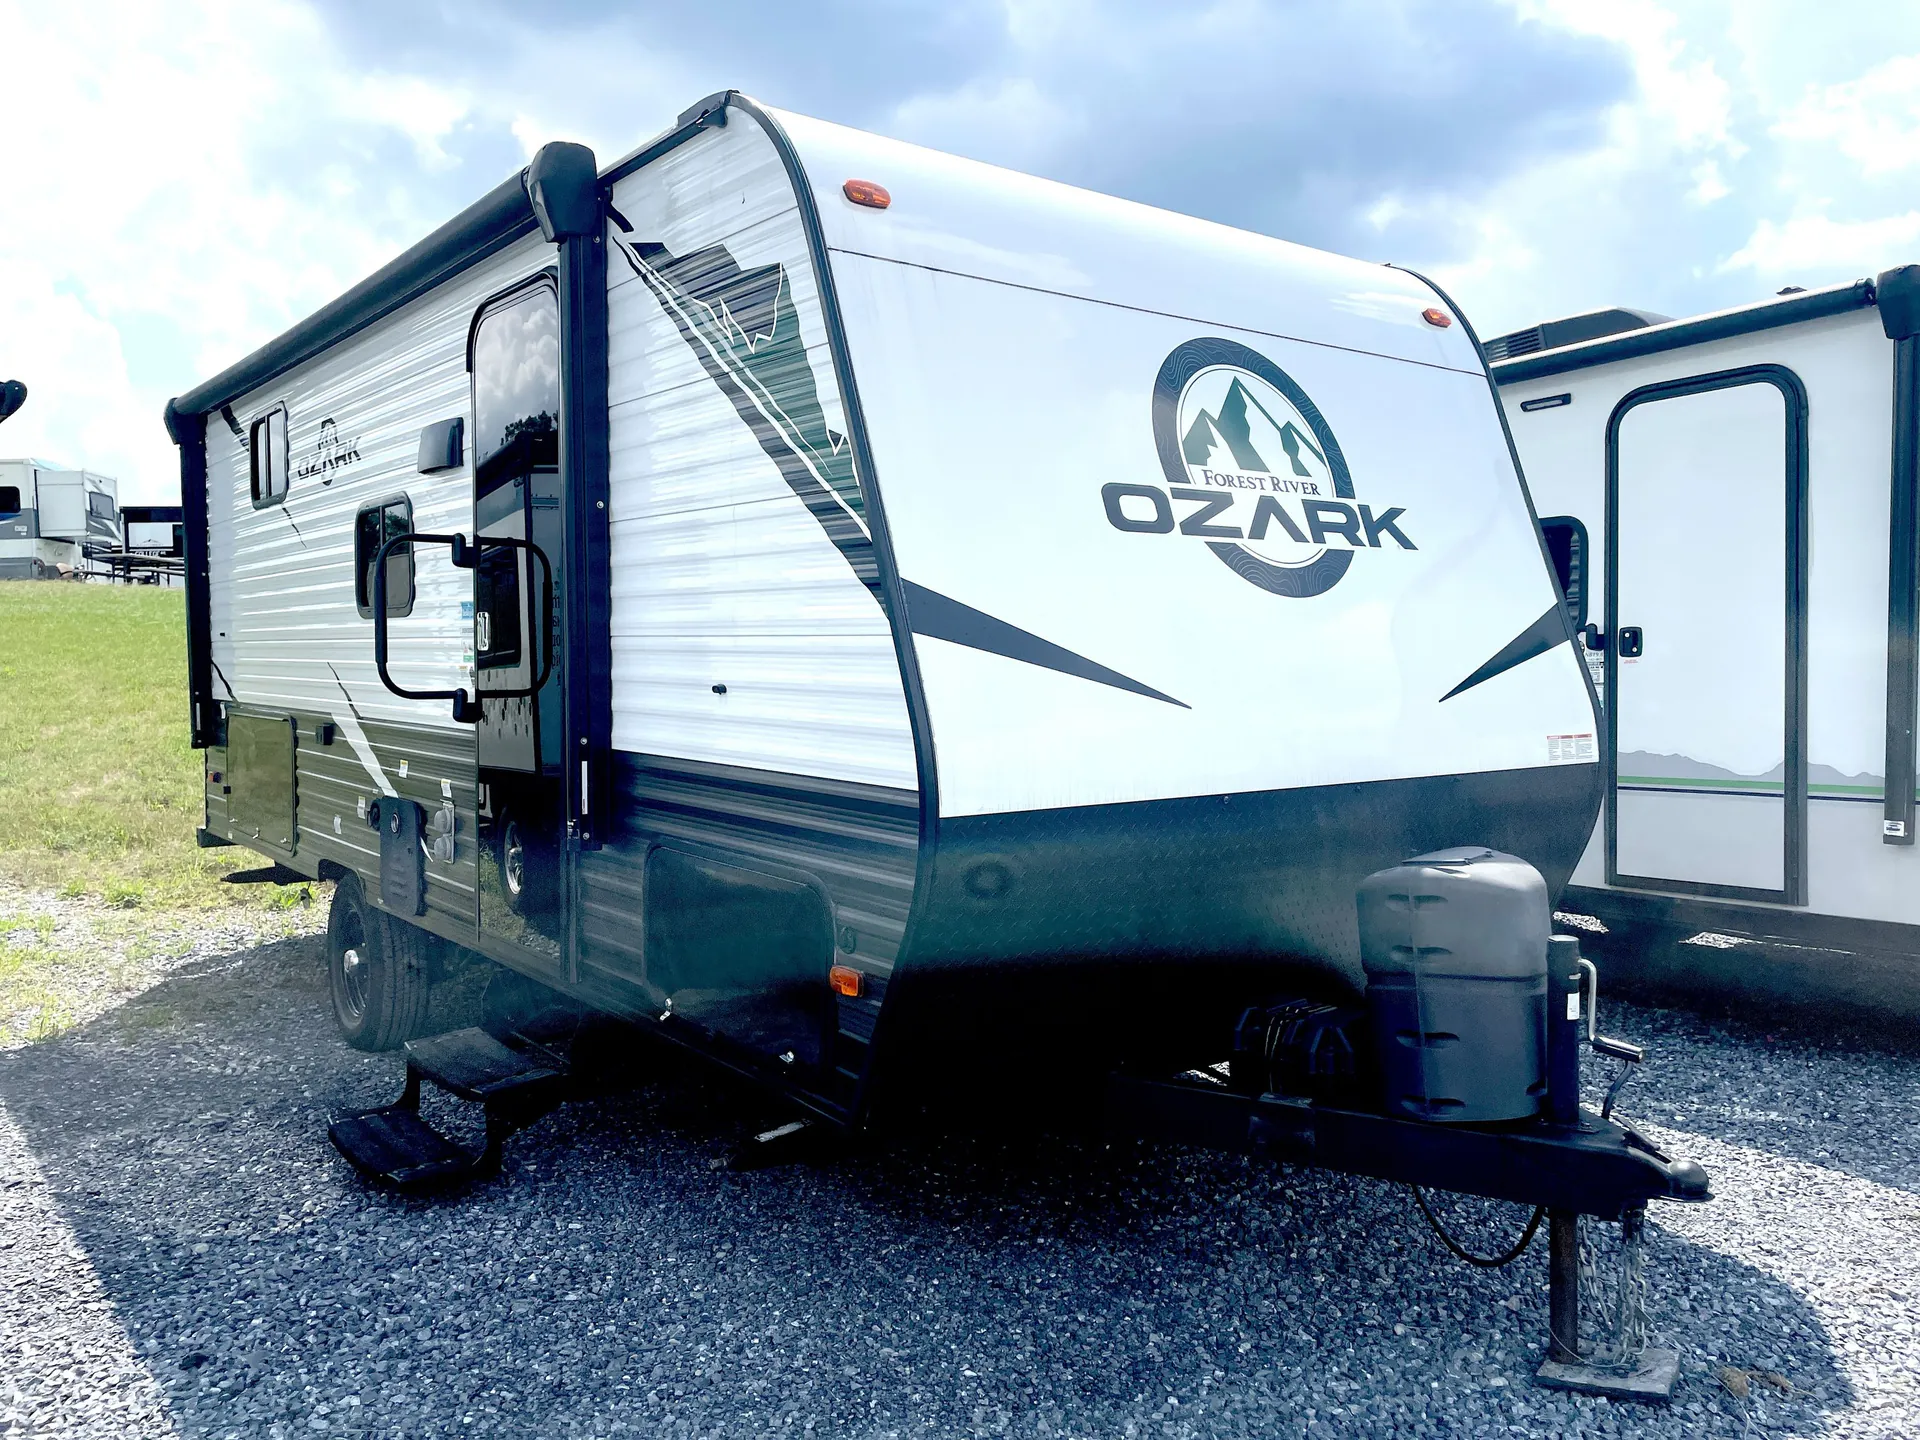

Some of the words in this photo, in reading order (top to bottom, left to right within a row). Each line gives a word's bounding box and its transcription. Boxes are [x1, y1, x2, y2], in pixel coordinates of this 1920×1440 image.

[298, 436, 361, 480] OZARK
[1203, 469, 1267, 491] FOREST
[1269, 476, 1321, 496] RIVER
[1101, 482, 1419, 551] OZARK
